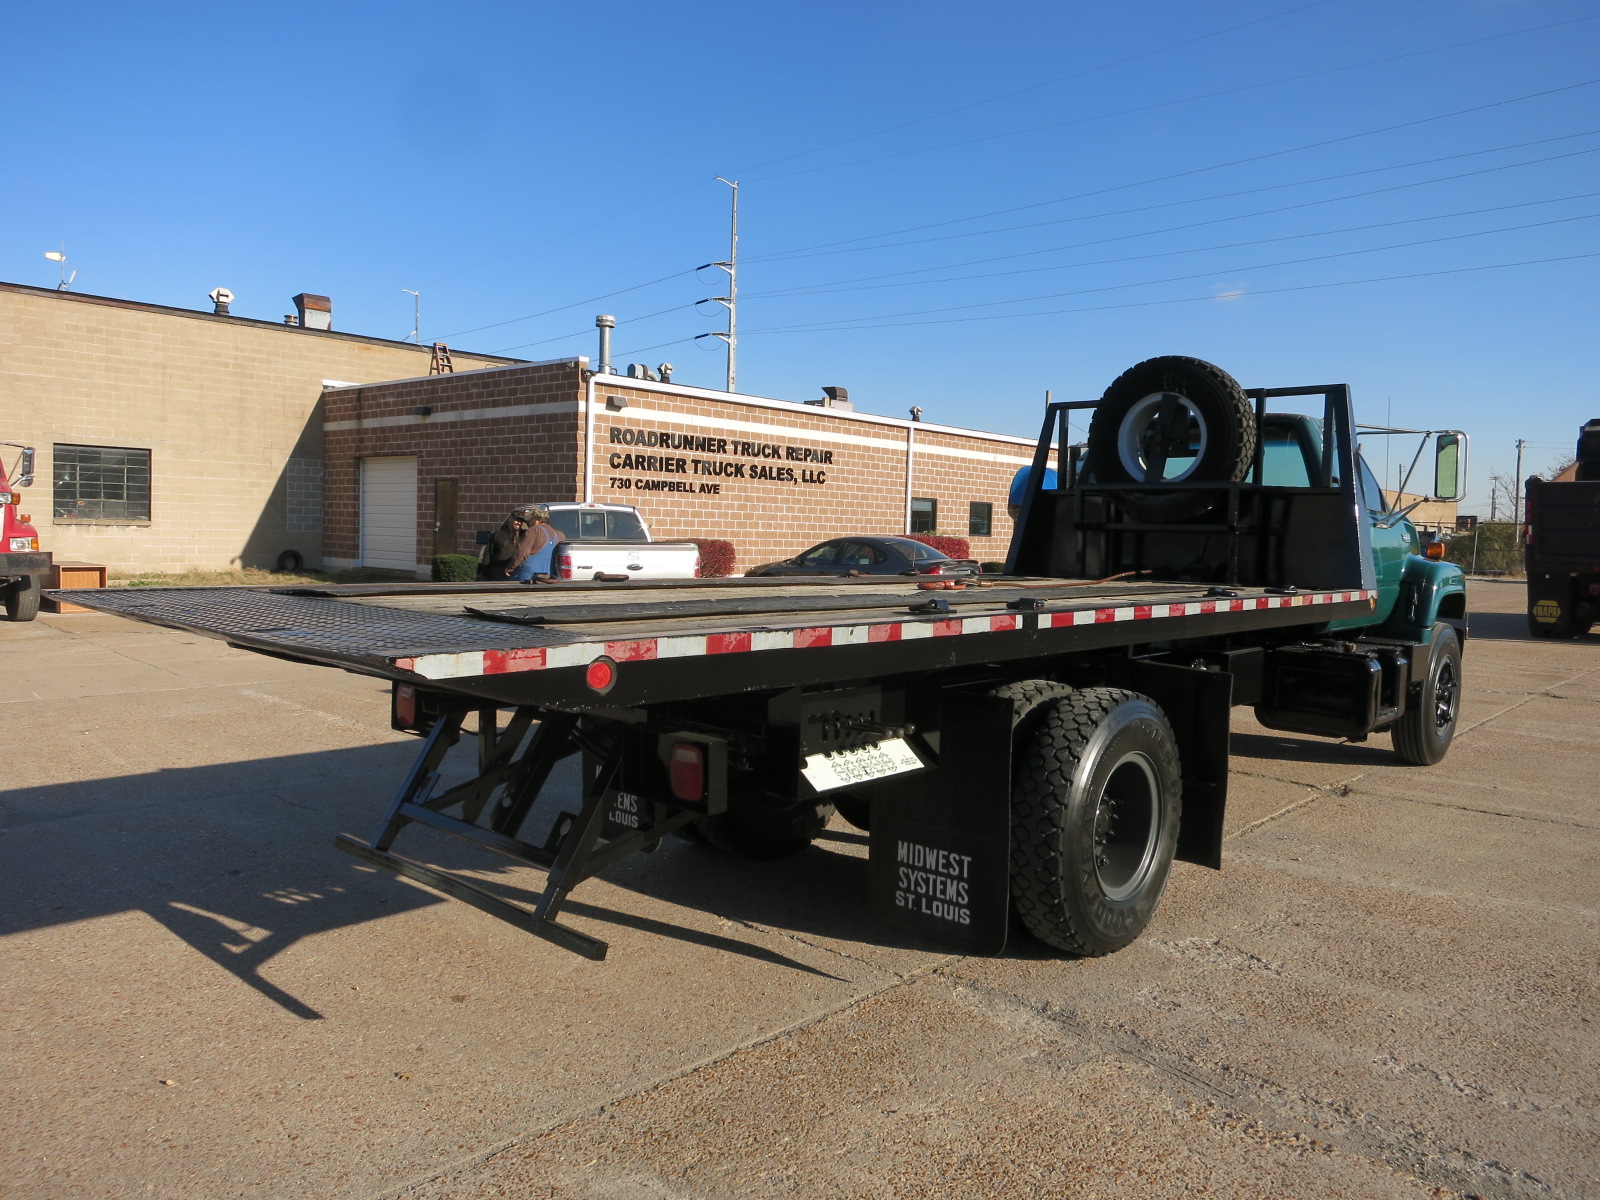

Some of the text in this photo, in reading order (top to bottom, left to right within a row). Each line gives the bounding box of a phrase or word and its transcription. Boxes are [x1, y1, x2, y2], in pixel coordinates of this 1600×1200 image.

[609, 427, 833, 465] ROADRUNNER TRUCK REPAIR
[609, 454, 826, 485] CARRIER TRUCK SALES, LLC
[609, 477, 721, 495] 730 CAMPBELL AVE
[1537, 606, 1557, 617] NAPA
[614, 792, 638, 812] EMS
[609, 811, 639, 828] LOUIS
[897, 840, 972, 878] MIDWEST
[898, 867, 969, 905] SYSTEMS
[895, 890, 971, 925] ST. LOUIS
